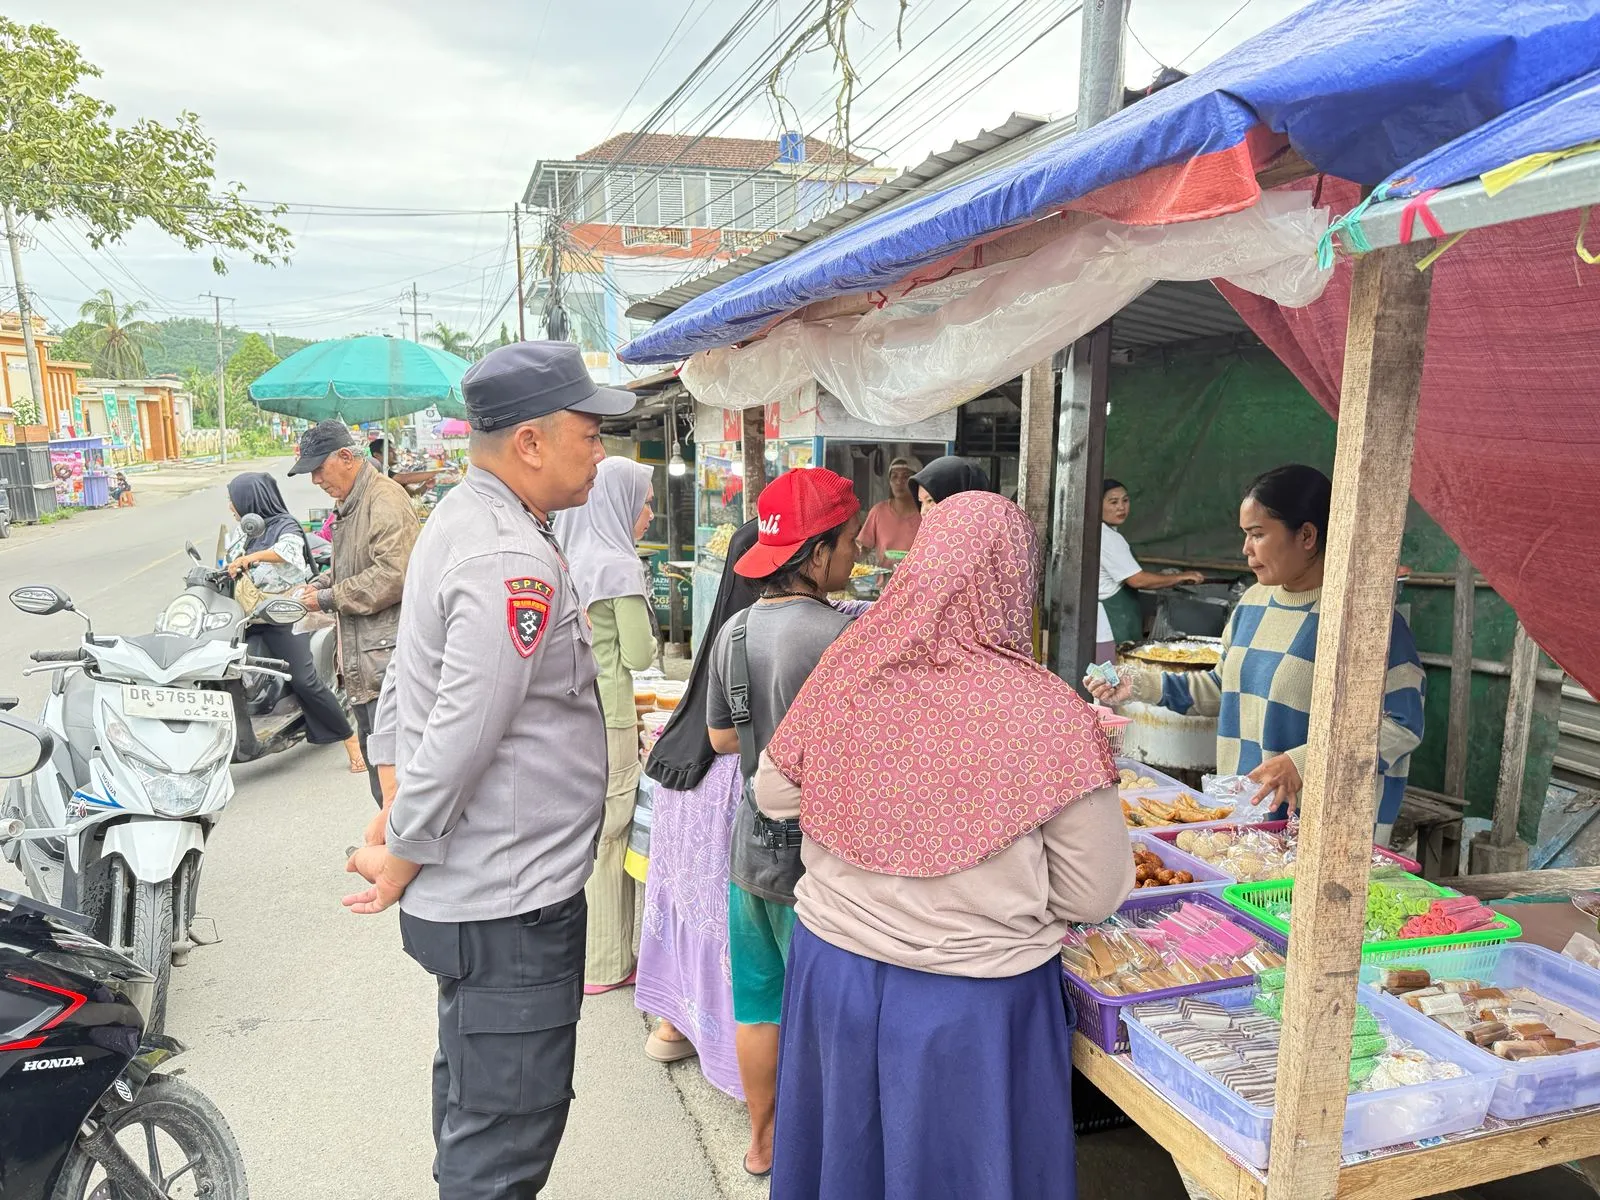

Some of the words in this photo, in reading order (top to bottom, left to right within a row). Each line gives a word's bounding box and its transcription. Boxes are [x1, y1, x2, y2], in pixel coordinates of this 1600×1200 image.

[511, 579, 552, 595] SPKT
[130, 688, 151, 701] DR
[155, 690, 196, 704] 5765
[203, 693, 225, 706] MJ
[22, 1056, 85, 1072] HONDA
